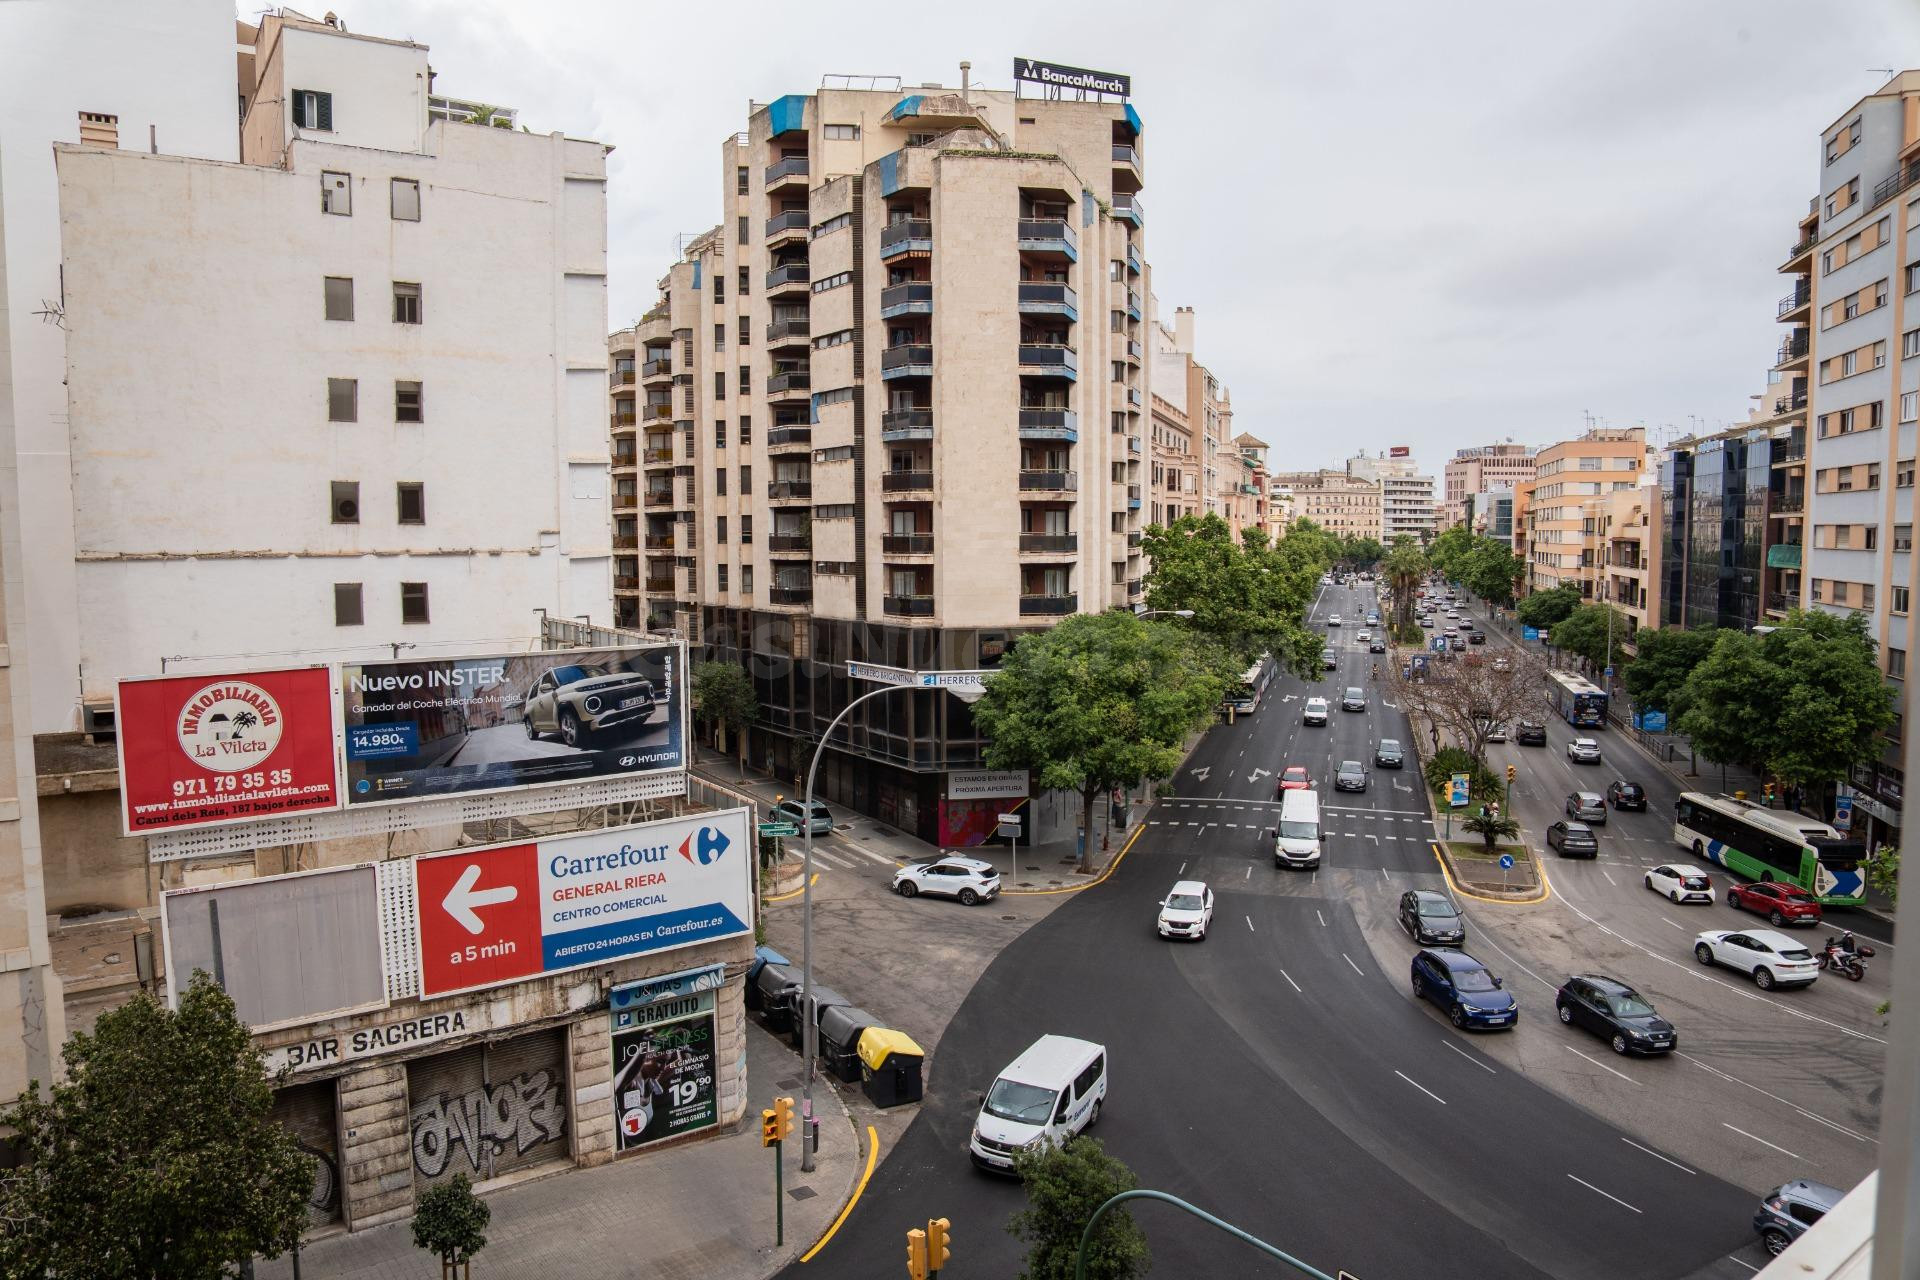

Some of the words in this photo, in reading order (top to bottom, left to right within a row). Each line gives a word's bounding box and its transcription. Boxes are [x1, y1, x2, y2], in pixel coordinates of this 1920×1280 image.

[1042, 68, 1122, 92] BancaMarch
[1415, 659, 1423, 668] P
[351, 674, 422, 693] Nuevo
[428, 667, 509, 687] INSTER.
[183, 686, 277, 735] INMOBILIARIA
[352, 704, 395, 713] Ganador
[398, 701, 411, 710] del
[413, 699, 443, 708] Coche
[445, 696, 483, 706] Eléctrico
[195, 744, 215, 758] La
[220, 740, 267, 756] Vileta
[353, 734, 405, 747] 14.980€
[638, 752, 678, 763] HYUNDAI
[173, 779, 208, 797] 971
[214, 775, 236, 792] 79
[242, 772, 264, 789] 35
[270, 769, 292, 785] 35
[135, 783, 330, 814] www.inmobiliarialavileta.com
[136, 813, 169, 826] Camí
[172, 810, 197, 822] dels
[200, 807, 229, 818] Reis,
[232, 803, 250, 814] 187
[254, 800, 284, 813] bajos
[286, 795, 330, 808] derecha
[550, 844, 669, 878] Carrefour
[553, 879, 622, 902] GENERAL
[625, 872, 667, 890] RIERA
[553, 905, 601, 922] CENTRO
[603, 894, 667, 914] COMERCIAL
[555, 942, 595, 958] ABIERTO
[596, 939, 608, 948] 24
[609, 934, 640, 947] HORAS
[641, 931, 653, 940] EN
[657, 916, 723, 937] Carrefour.es
[451, 951, 461, 964] a
[466, 946, 477, 962] 5
[481, 939, 516, 958] min
[620, 1014, 628, 1024] P
[637, 997, 698, 1024] GRATUITO
[287, 1039, 339, 1067] BAR
[352, 1012, 466, 1052] SAGRERA
[622, 1040, 654, 1062] JOEL
[678, 1054, 710, 1067] GIMNASIO
[684, 1062, 704, 1072] MODA
[674, 1116, 690, 1126] HORAS
